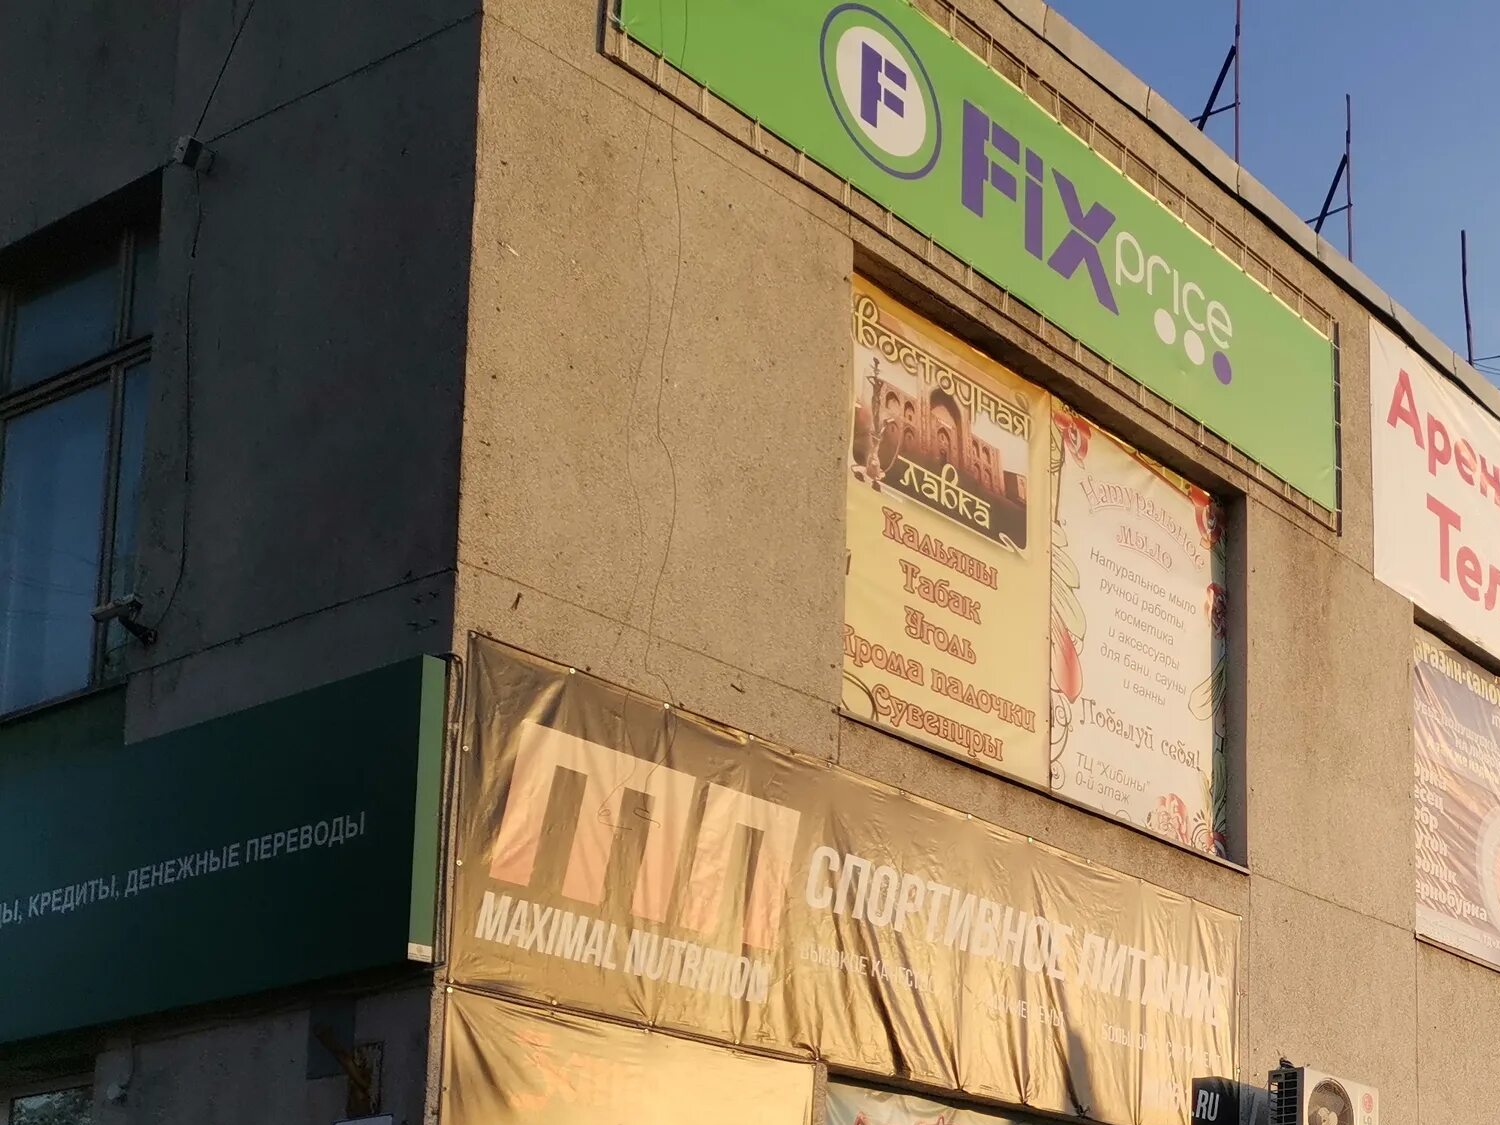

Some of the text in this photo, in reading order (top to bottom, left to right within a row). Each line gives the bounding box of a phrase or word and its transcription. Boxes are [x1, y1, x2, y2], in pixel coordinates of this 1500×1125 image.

[860, 42, 907, 127] F
[881, 506, 998, 590] Кальяны
[1090, 546, 1197, 616] Натуральное мыло
[899, 559, 982, 625] Табак
[1100, 578, 1139, 606] ручной
[904, 605, 976, 664] Уголь
[1108, 626, 1180, 671] и аксессуары
[1115, 607, 1174, 645] косметика
[931, 667, 1036, 733] палочки
[1100, 642, 1121, 663] для
[1155, 672, 1187, 696] сауны
[1123, 678, 1166, 706] и ванны
[871, 683, 1004, 762] Сувениры
[1080, 697, 1201, 772] Побалуй себя!
[1076, 752, 1095, 773] ТЦ
[1098, 781, 1131, 803] этаж
[28, 874, 119, 921] КРЕДИТЫ,
[124, 842, 240, 898] ДЕНЕЖНЫЕ
[245, 811, 366, 866] ПЕРЕВОДЫ
[475, 890, 772, 1002] MAXIMAL NUTRITION
[806, 845, 1073, 981] СПОРТИВНОЕ
